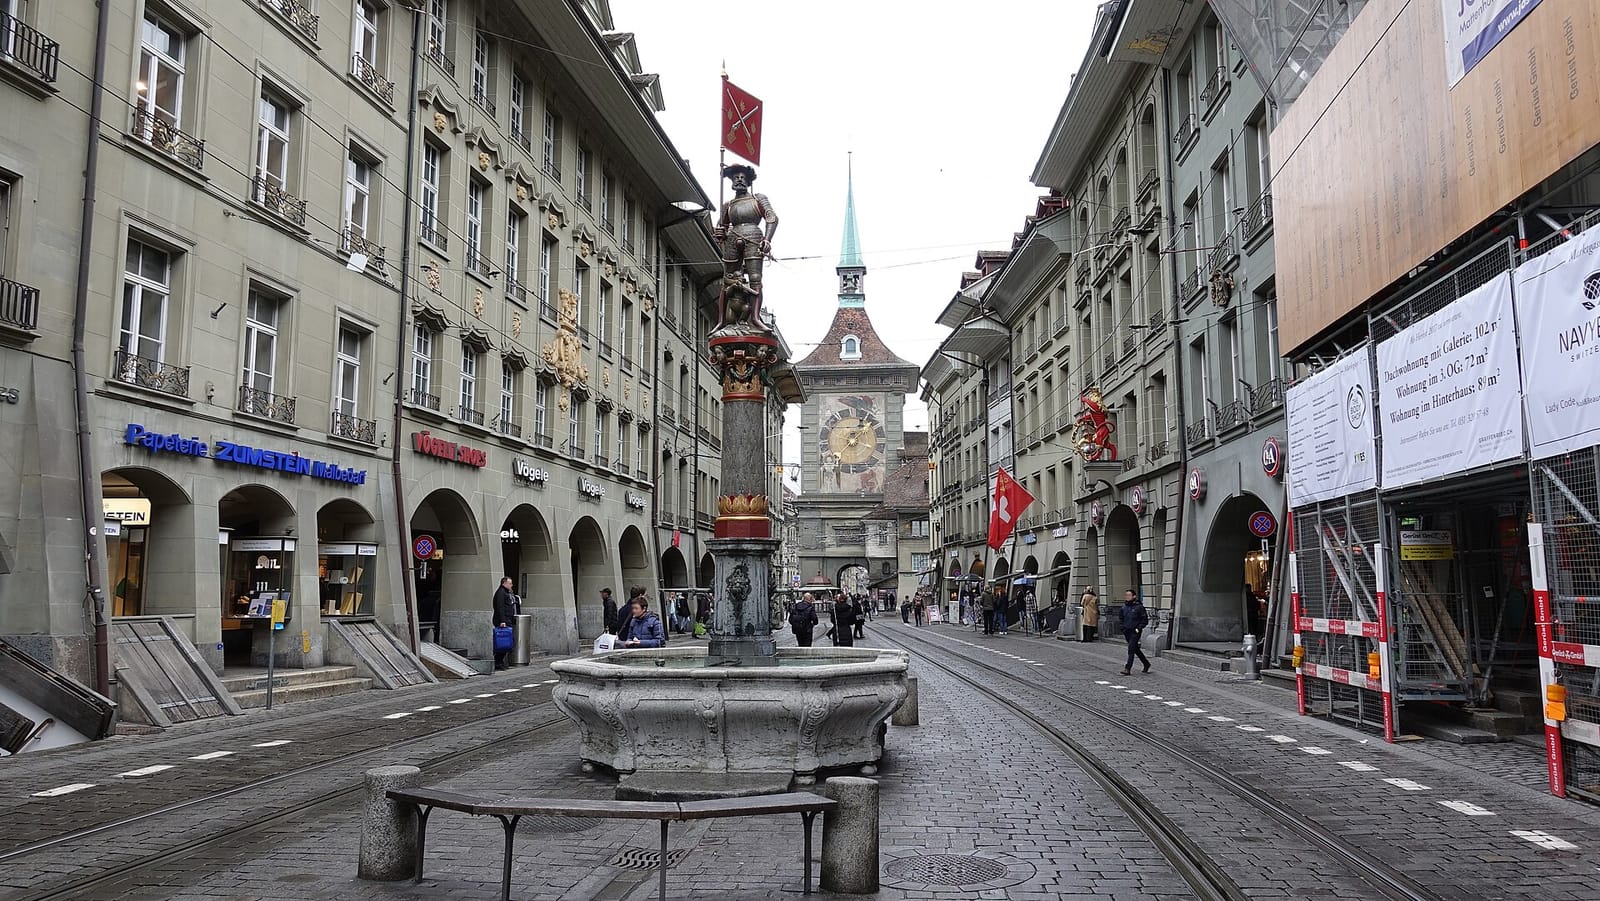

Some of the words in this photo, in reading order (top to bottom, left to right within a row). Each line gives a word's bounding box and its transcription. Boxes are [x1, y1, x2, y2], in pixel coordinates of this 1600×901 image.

[1563, 15, 1576, 56] GmbH
[1527, 47, 1538, 85] GmbH
[1566, 57, 1579, 101] Gerüst
[1530, 85, 1542, 127] Gerüst
[1384, 355, 1429, 383] Dachwohnung
[1430, 345, 1442, 361] mit
[1443, 332, 1473, 354] Galerie:
[1475, 321, 1489, 339] 102
[1396, 379, 1428, 399] Wohnung
[1429, 373, 1438, 385] im
[1560, 397, 1575, 409] Code
[1390, 405, 1421, 424] Wohnung
[1421, 398, 1431, 413] im
[1432, 384, 1475, 409] Hinterhaus:
[125, 423, 208, 457] Papeterie
[412, 431, 457, 460] VÖGELE
[459, 445, 487, 468] SHOES
[215, 440, 312, 476] ZUMSTEIN
[313, 461, 367, 485] Malbedarf
[516, 460, 549, 482] Vögele
[580, 478, 606, 497] Vögele
[627, 491, 648, 508] Vögele
[104, 512, 146, 521] STEIN
